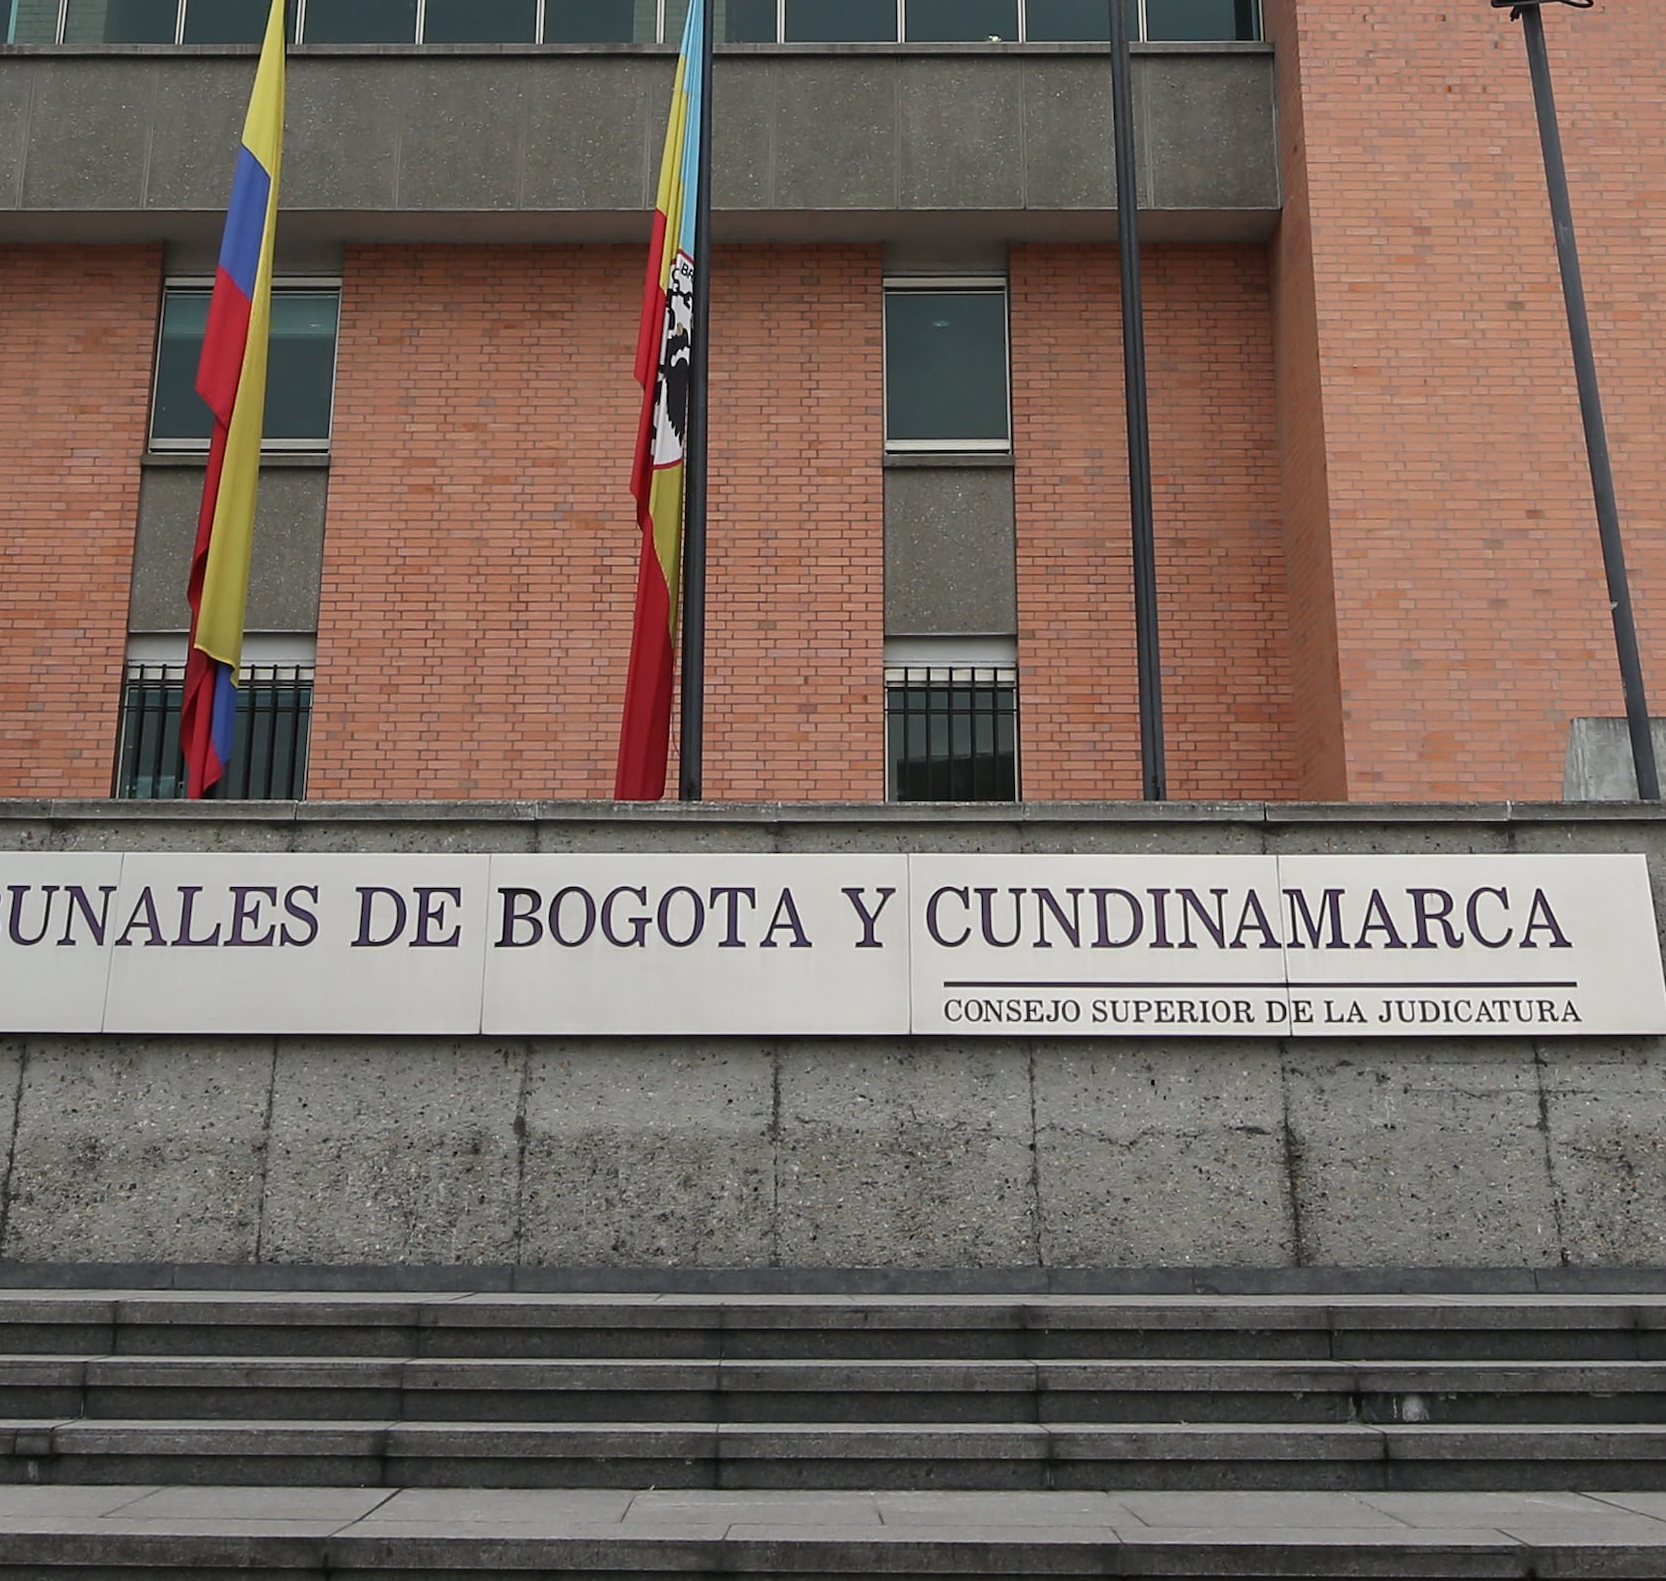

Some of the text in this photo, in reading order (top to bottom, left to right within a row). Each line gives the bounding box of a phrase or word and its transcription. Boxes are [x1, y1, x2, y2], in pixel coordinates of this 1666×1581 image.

[350, 885, 462, 948] DE
[493, 885, 813, 948] BOGOTA
[840, 886, 897, 948] Y
[925, 885, 1574, 950] CUNDINAMARCA
[943, 998, 1584, 1024] CONSEJO SUPERIOR DE LA JUDICATURA
